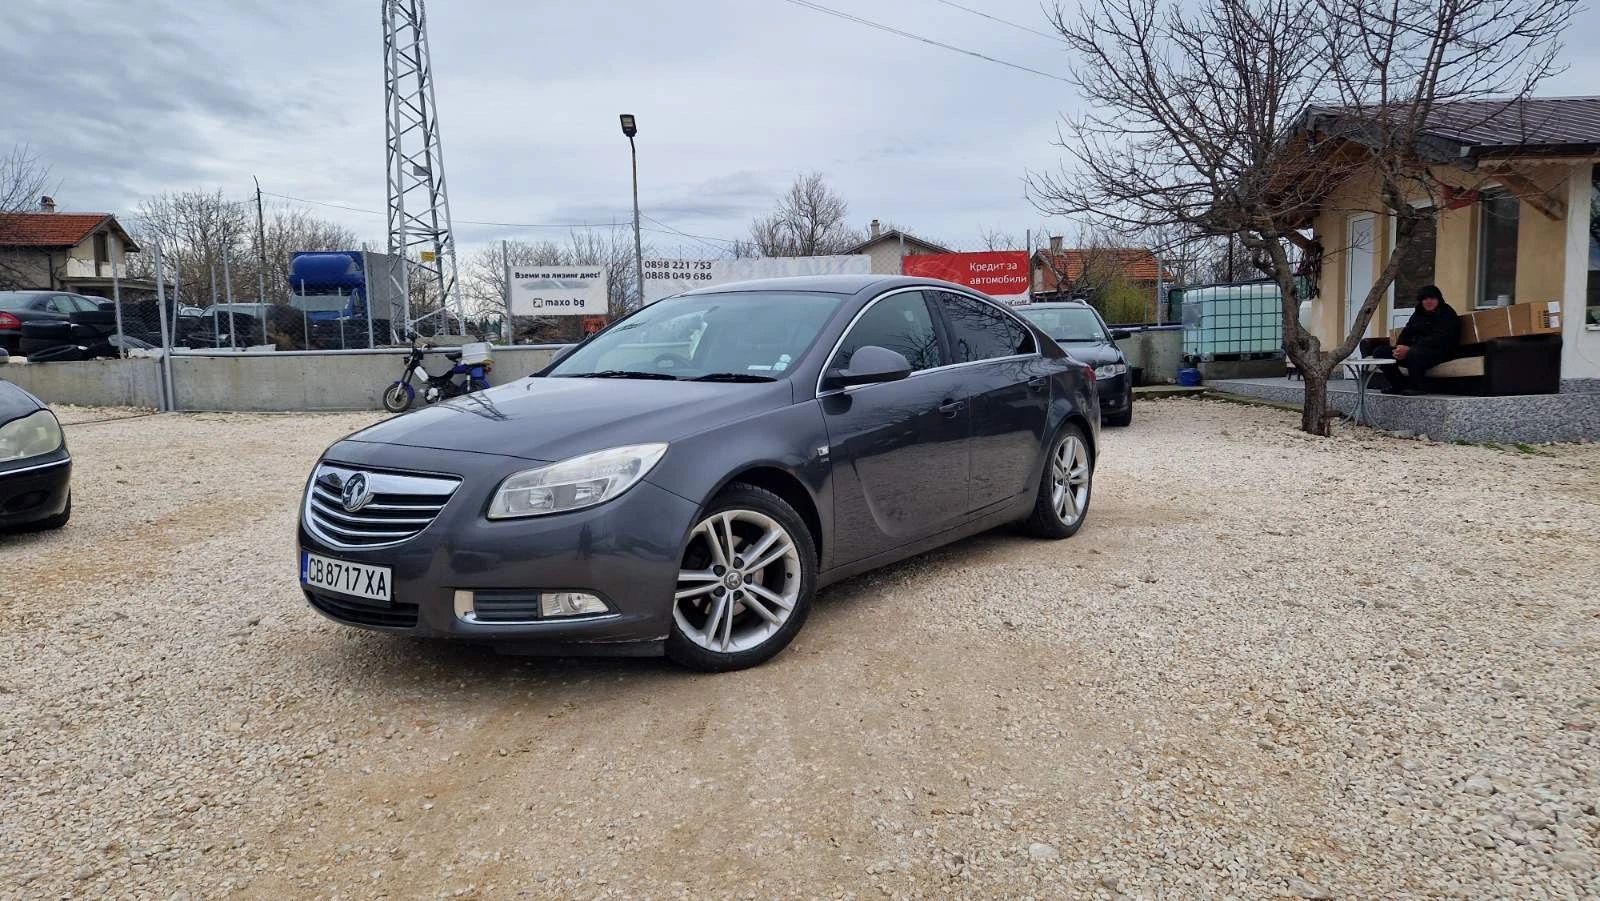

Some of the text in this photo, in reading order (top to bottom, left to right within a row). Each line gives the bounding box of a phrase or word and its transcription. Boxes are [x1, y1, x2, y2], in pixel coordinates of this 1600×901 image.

[644, 260, 712, 270] 0898 221 753
[969, 262, 1018, 272] Кредит за
[514, 271, 540, 279] Вземи
[579, 271, 601, 280] днес!
[644, 271, 713, 281] 0888 049 686
[969, 274, 1027, 285] автомобили
[545, 299, 571, 307] maxo
[309, 558, 387, 597] CB 8717 XA
